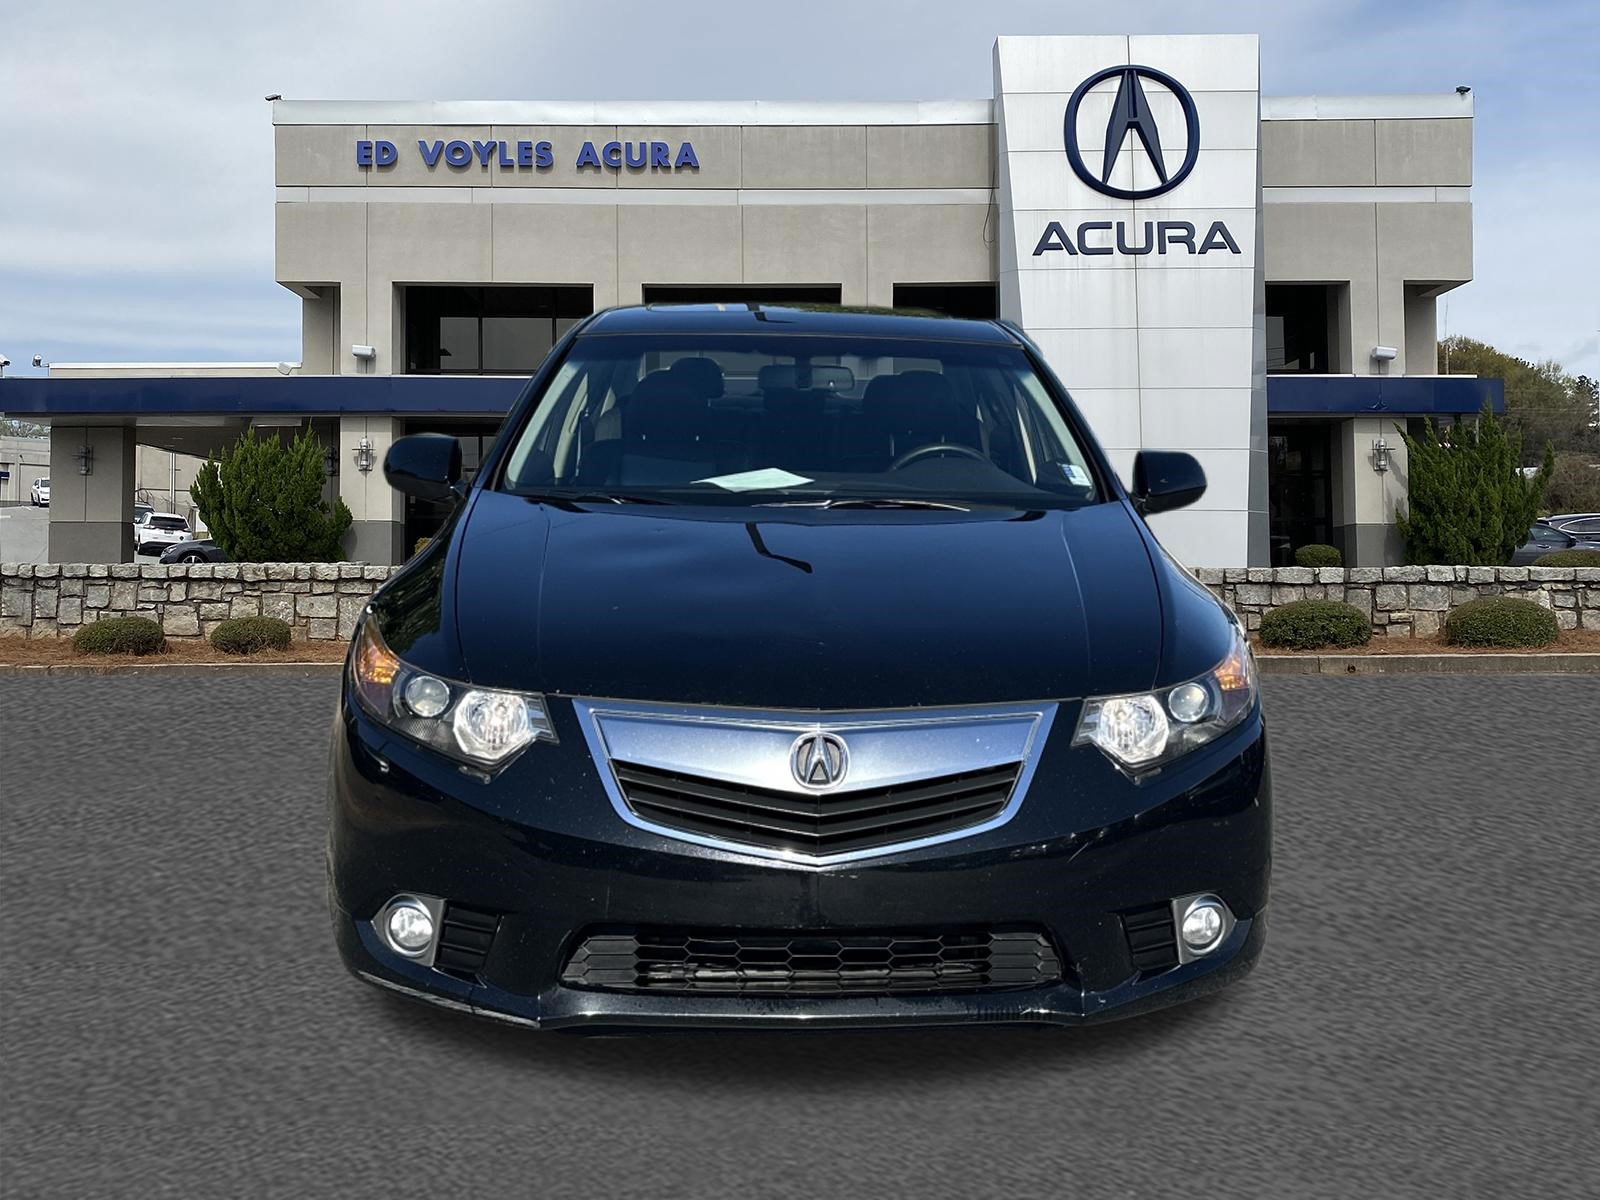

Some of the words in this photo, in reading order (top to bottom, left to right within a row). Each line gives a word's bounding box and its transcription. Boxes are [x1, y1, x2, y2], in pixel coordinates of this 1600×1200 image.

[356, 140, 397, 168] ED
[418, 140, 553, 169] VOYLES
[576, 141, 700, 170] ACURA
[1033, 221, 1241, 256] ACURA
